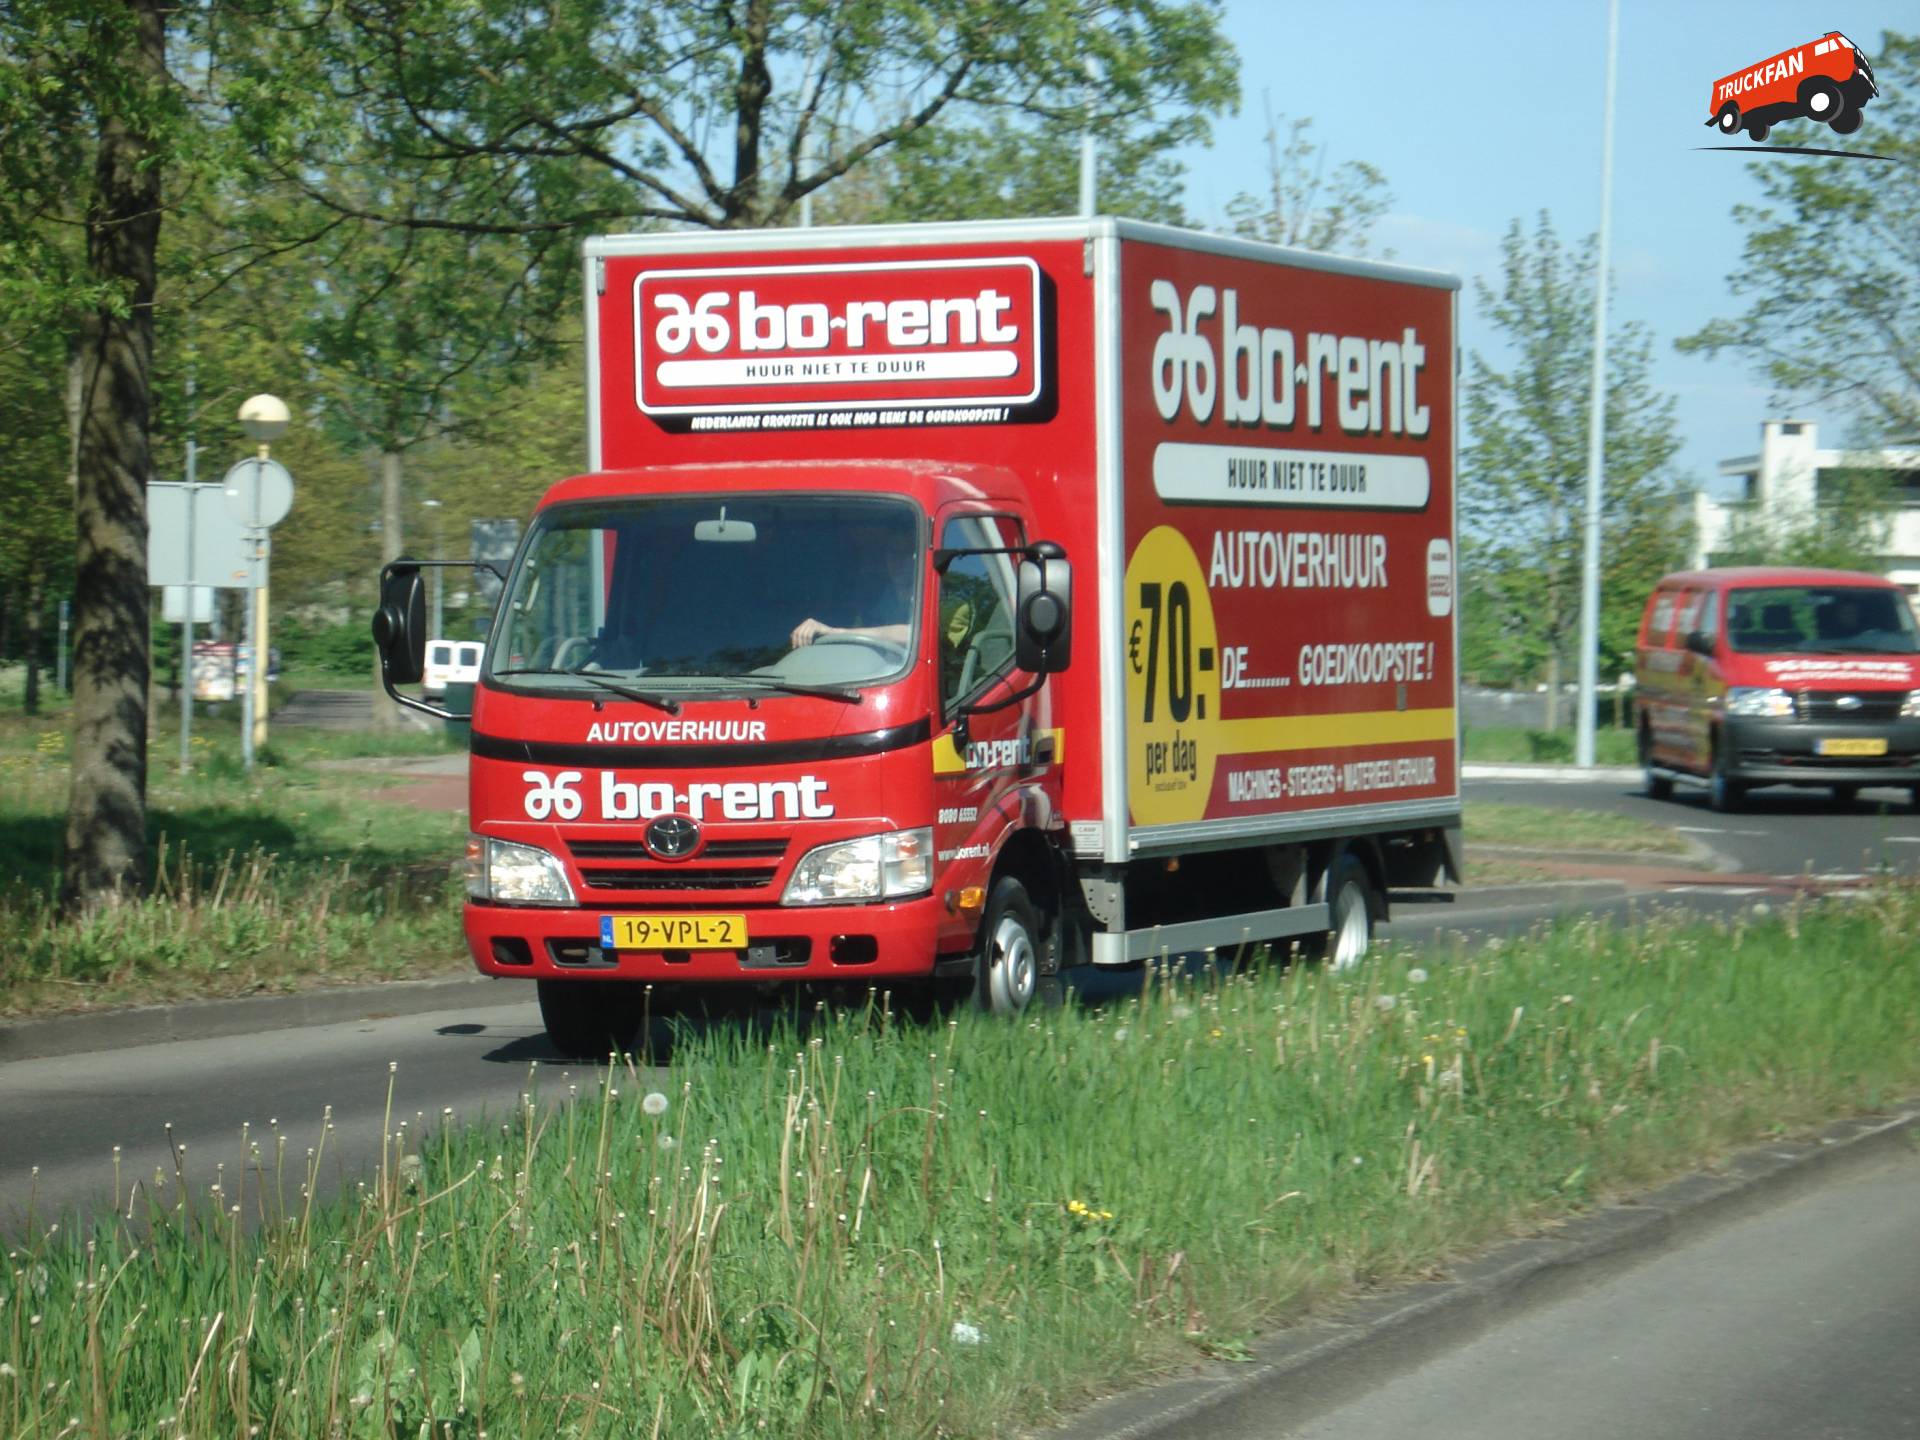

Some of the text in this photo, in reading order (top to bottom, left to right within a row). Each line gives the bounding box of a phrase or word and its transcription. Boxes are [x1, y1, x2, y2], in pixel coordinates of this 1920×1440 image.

[746, 360, 926, 377] HUUR NIET TE DUUR
[691, 416, 760, 430] NEDERLANDS
[762, 414, 815, 428] GROOTSTE
[817, 413, 828, 426] IS
[830, 412, 852, 425] OOK
[853, 411, 877, 425] NOG
[879, 410, 907, 425] EENS
[908, 409, 924, 423] DE
[925, 408, 1002, 423] GOEDKOOPSTE
[1228, 458, 1366, 492] HUUR NIET TE DUUR
[1209, 531, 1388, 588] AUTOVERHUUR
[586, 720, 766, 742] AUTOVERHUUR
[1146, 729, 1197, 785] per dag
[625, 920, 733, 943] 19-VPL-2
